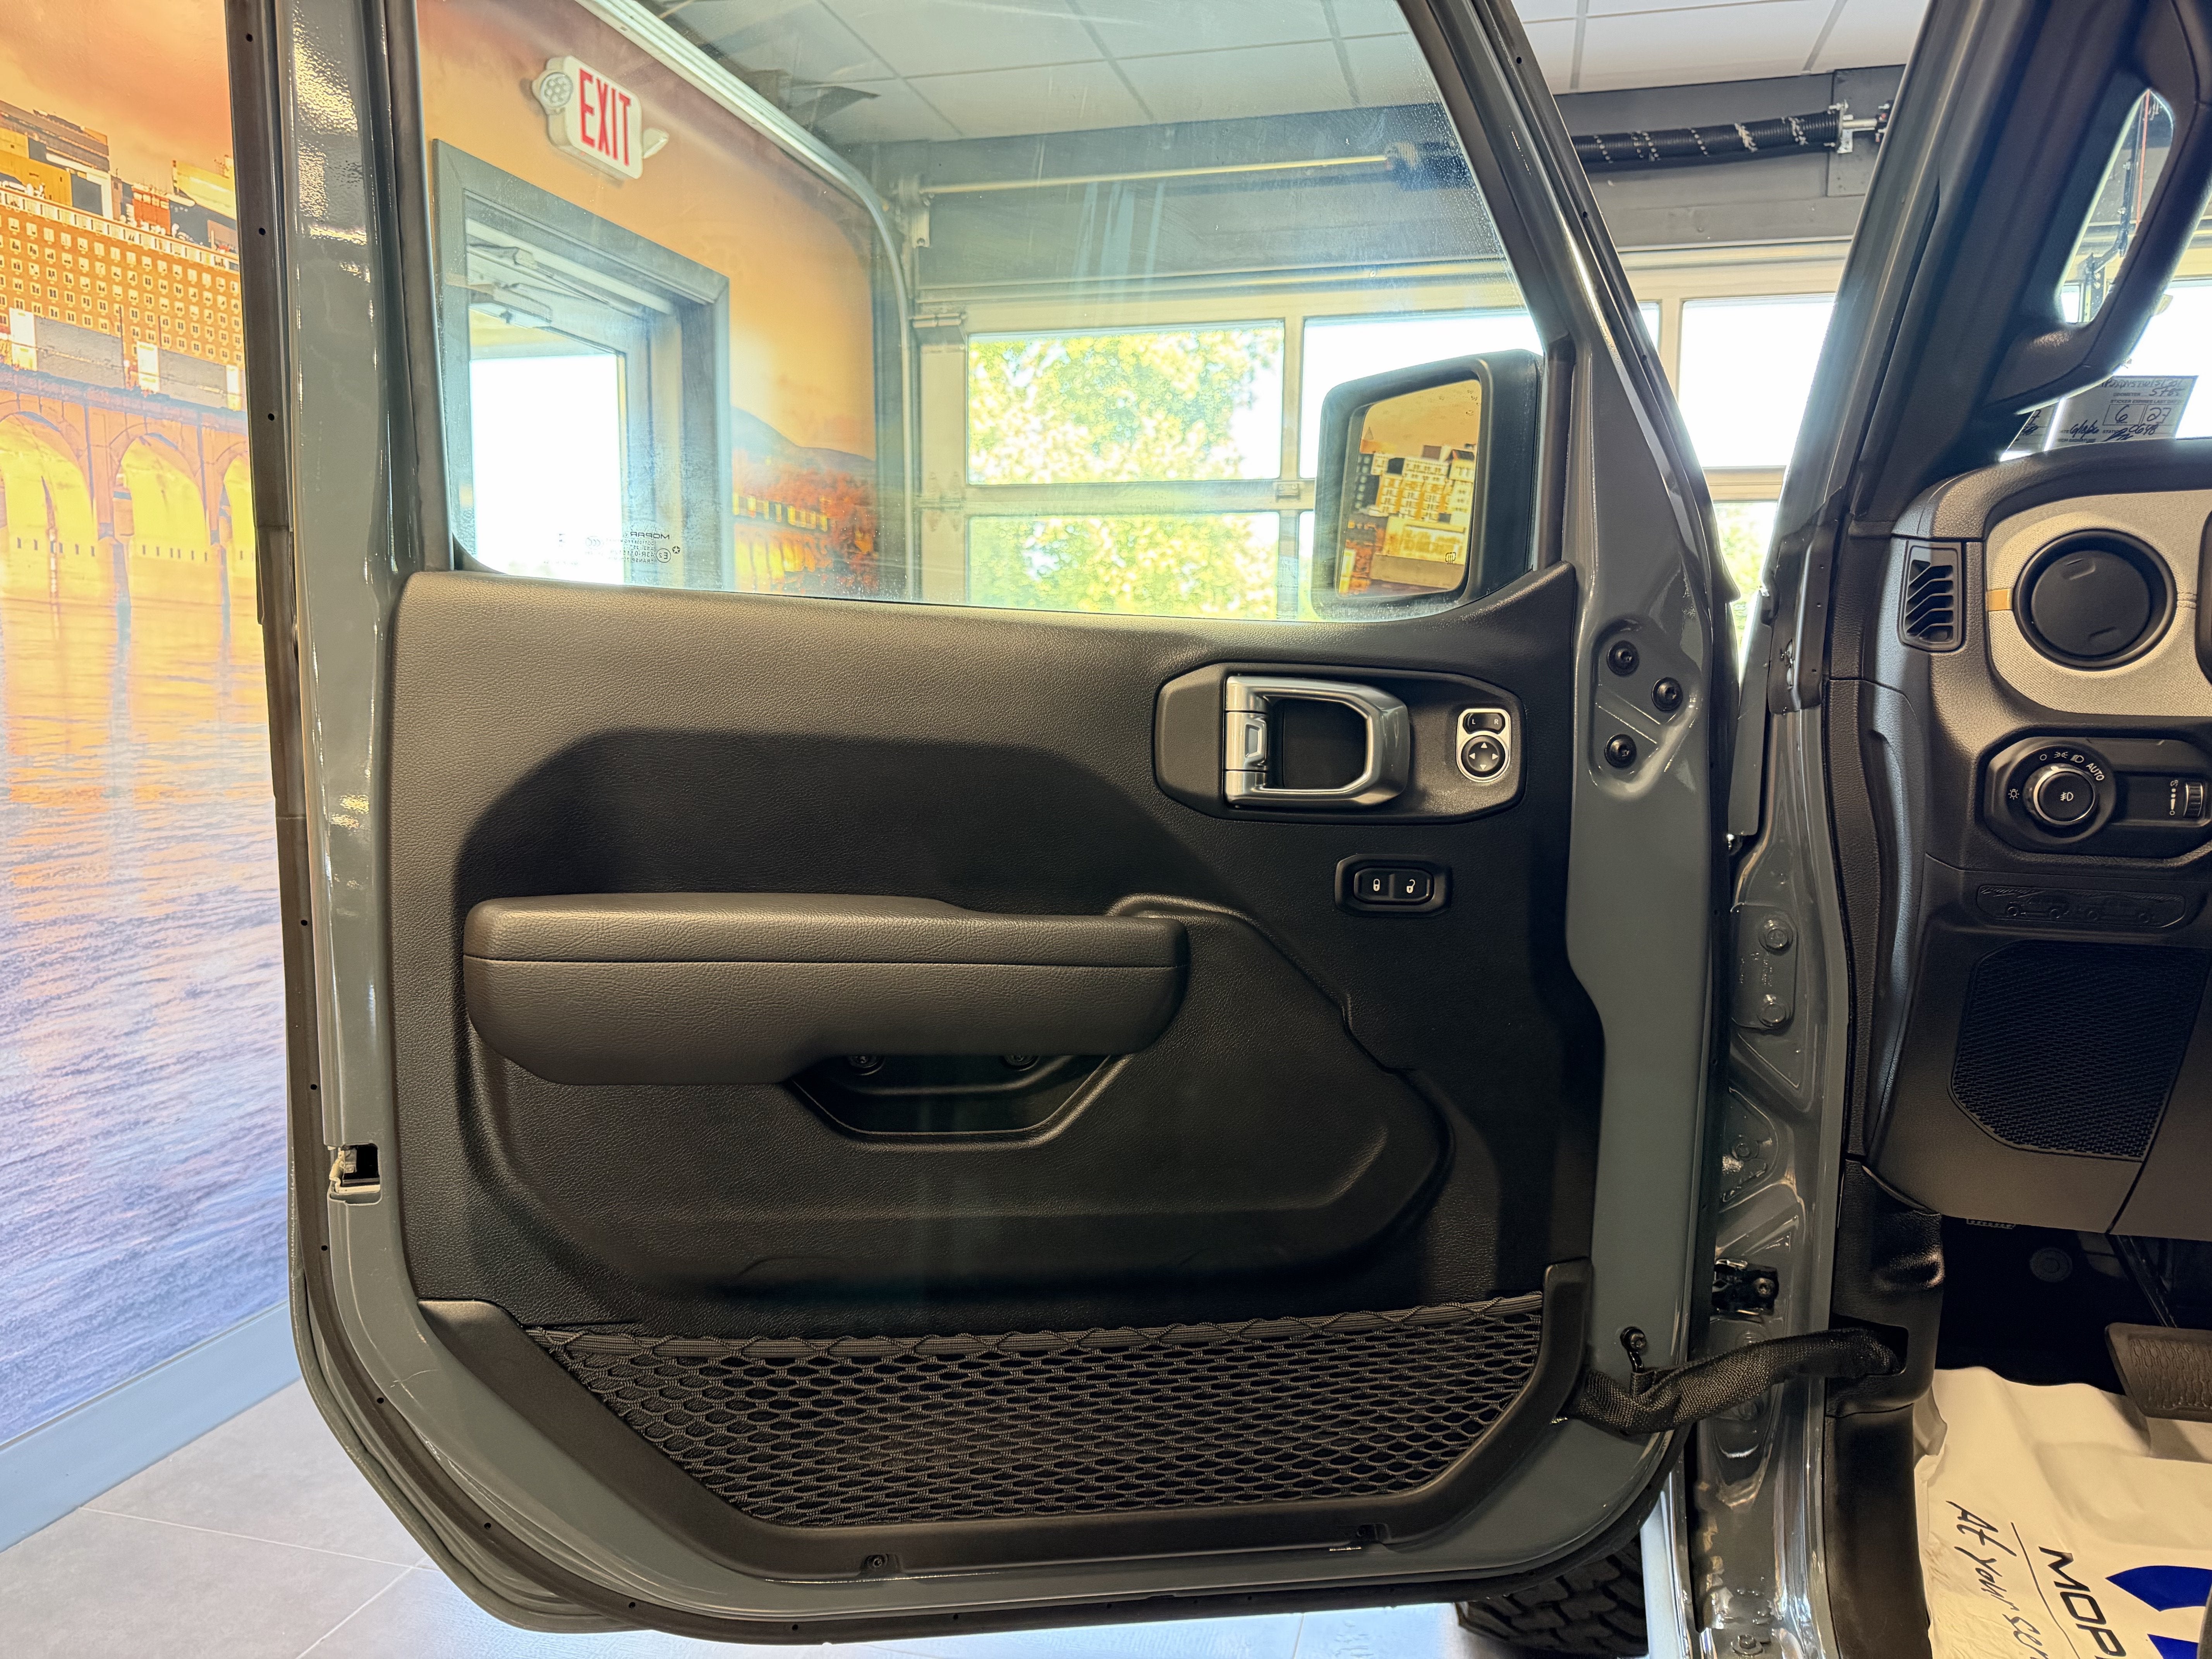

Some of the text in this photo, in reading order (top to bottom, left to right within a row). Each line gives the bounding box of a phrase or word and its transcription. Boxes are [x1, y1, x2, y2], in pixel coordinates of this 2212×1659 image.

[579, 68, 631, 166] EXIT
[2115, 405, 2171, 424] 6 27
[2085, 763, 2105, 781] AUTO
[1946, 1500, 2017, 1557] At
[1954, 1546, 2020, 1611] Your
[2038, 1546, 2126, 1659] MOP
